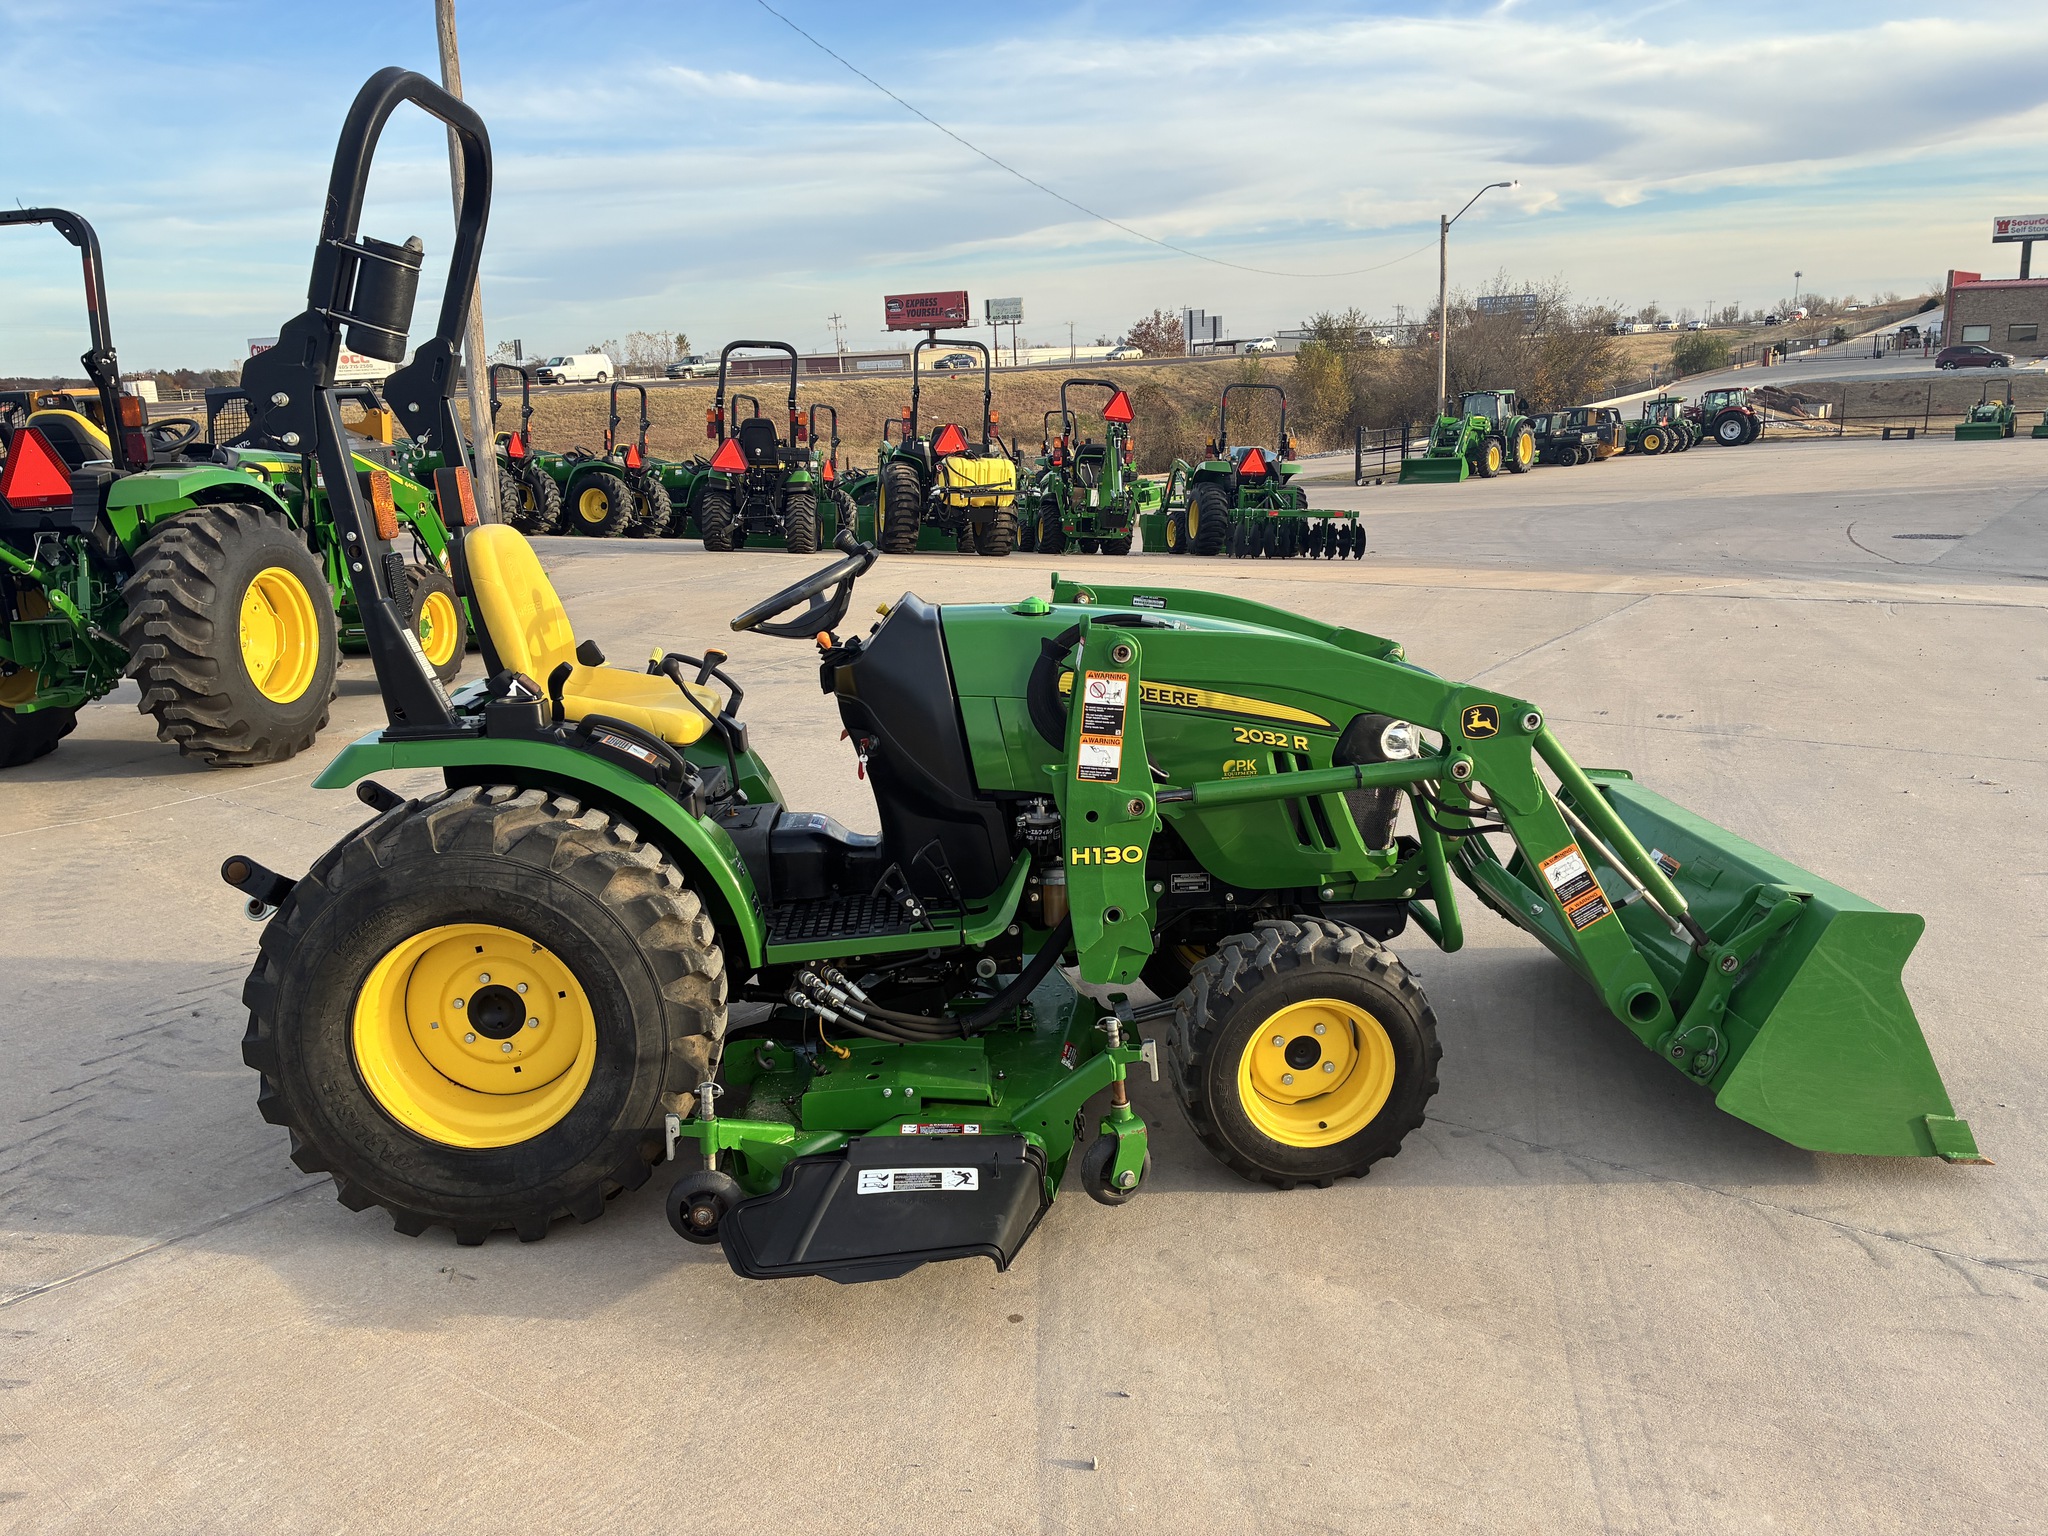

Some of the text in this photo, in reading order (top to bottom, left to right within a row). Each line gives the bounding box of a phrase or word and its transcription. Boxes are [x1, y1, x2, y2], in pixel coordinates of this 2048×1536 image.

[2010, 226, 2027, 234] Self
[905, 297, 938, 308] EXPRESS
[1095, 672, 1127, 680] WARNING
[1088, 737, 1121, 745] WARNING
[1232, 727, 1310, 751] 2032 R
[1071, 845, 1144, 866] H130
[1574, 892, 1598, 908] WARNING
